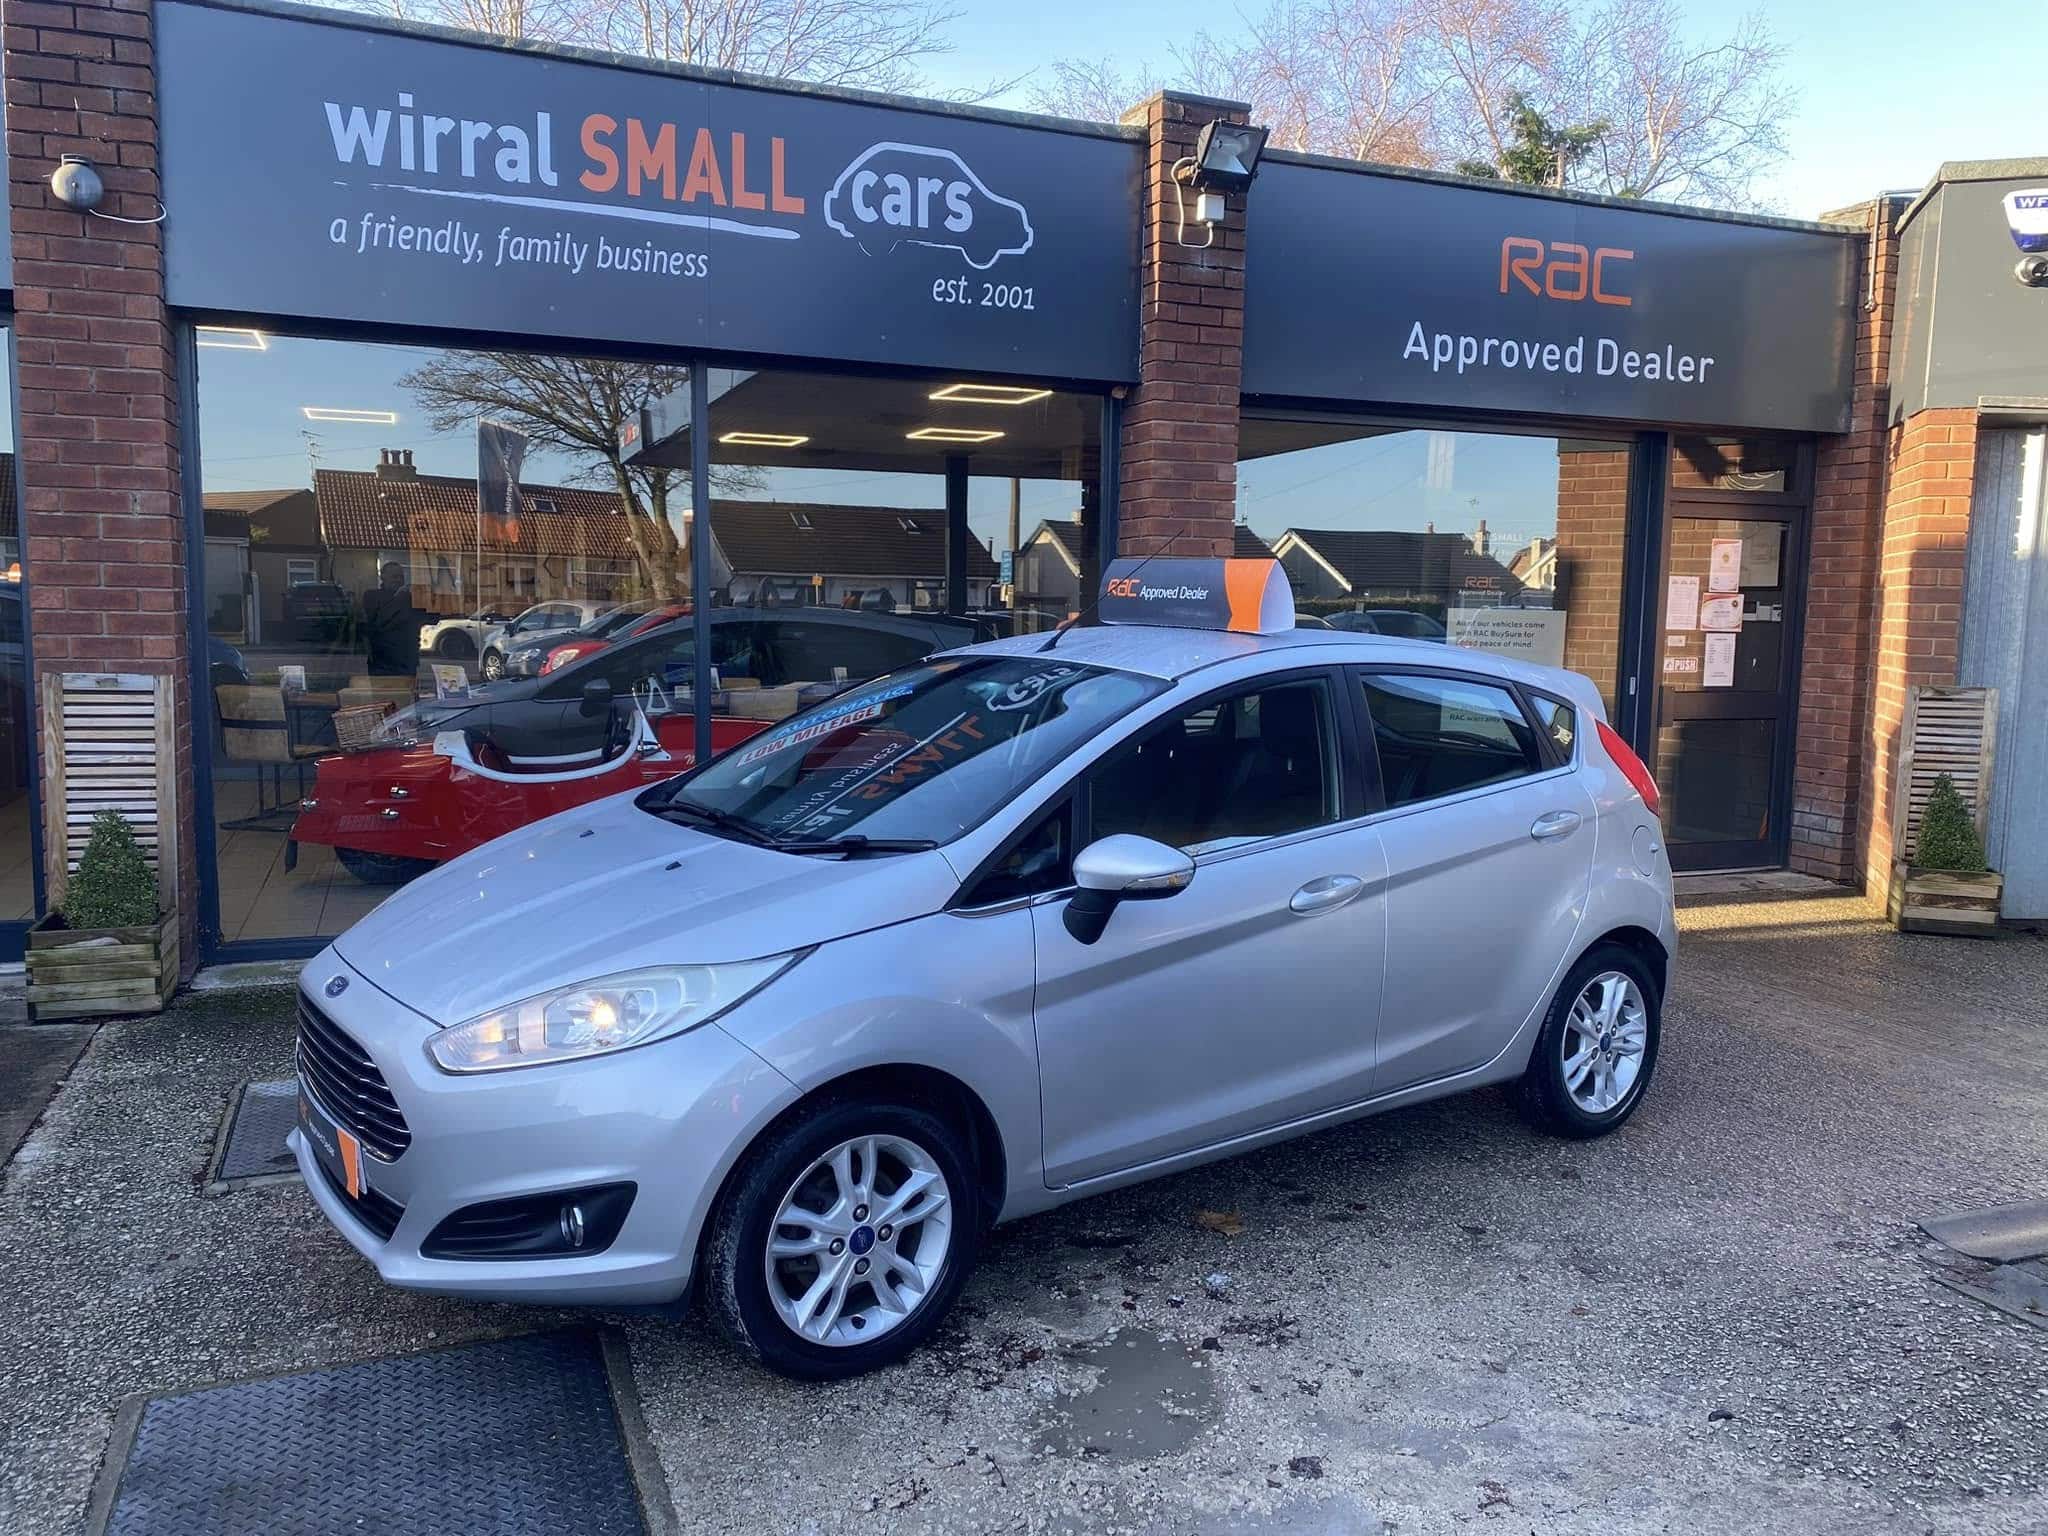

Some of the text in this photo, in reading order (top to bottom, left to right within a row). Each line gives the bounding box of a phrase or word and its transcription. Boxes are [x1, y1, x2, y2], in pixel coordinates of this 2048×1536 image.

[324, 92, 973, 232] wirral SMALL cars
[328, 212, 709, 279] a friendly, family business
[932, 274, 1036, 311] est. 2001
[1403, 321, 1715, 383] Approved Dealer
[1140, 585, 1179, 600] Approved
[1180, 586, 1209, 600] Dealer
[1479, 640, 1501, 648] peace
[744, 704, 878, 763] LOW MILEAGE
